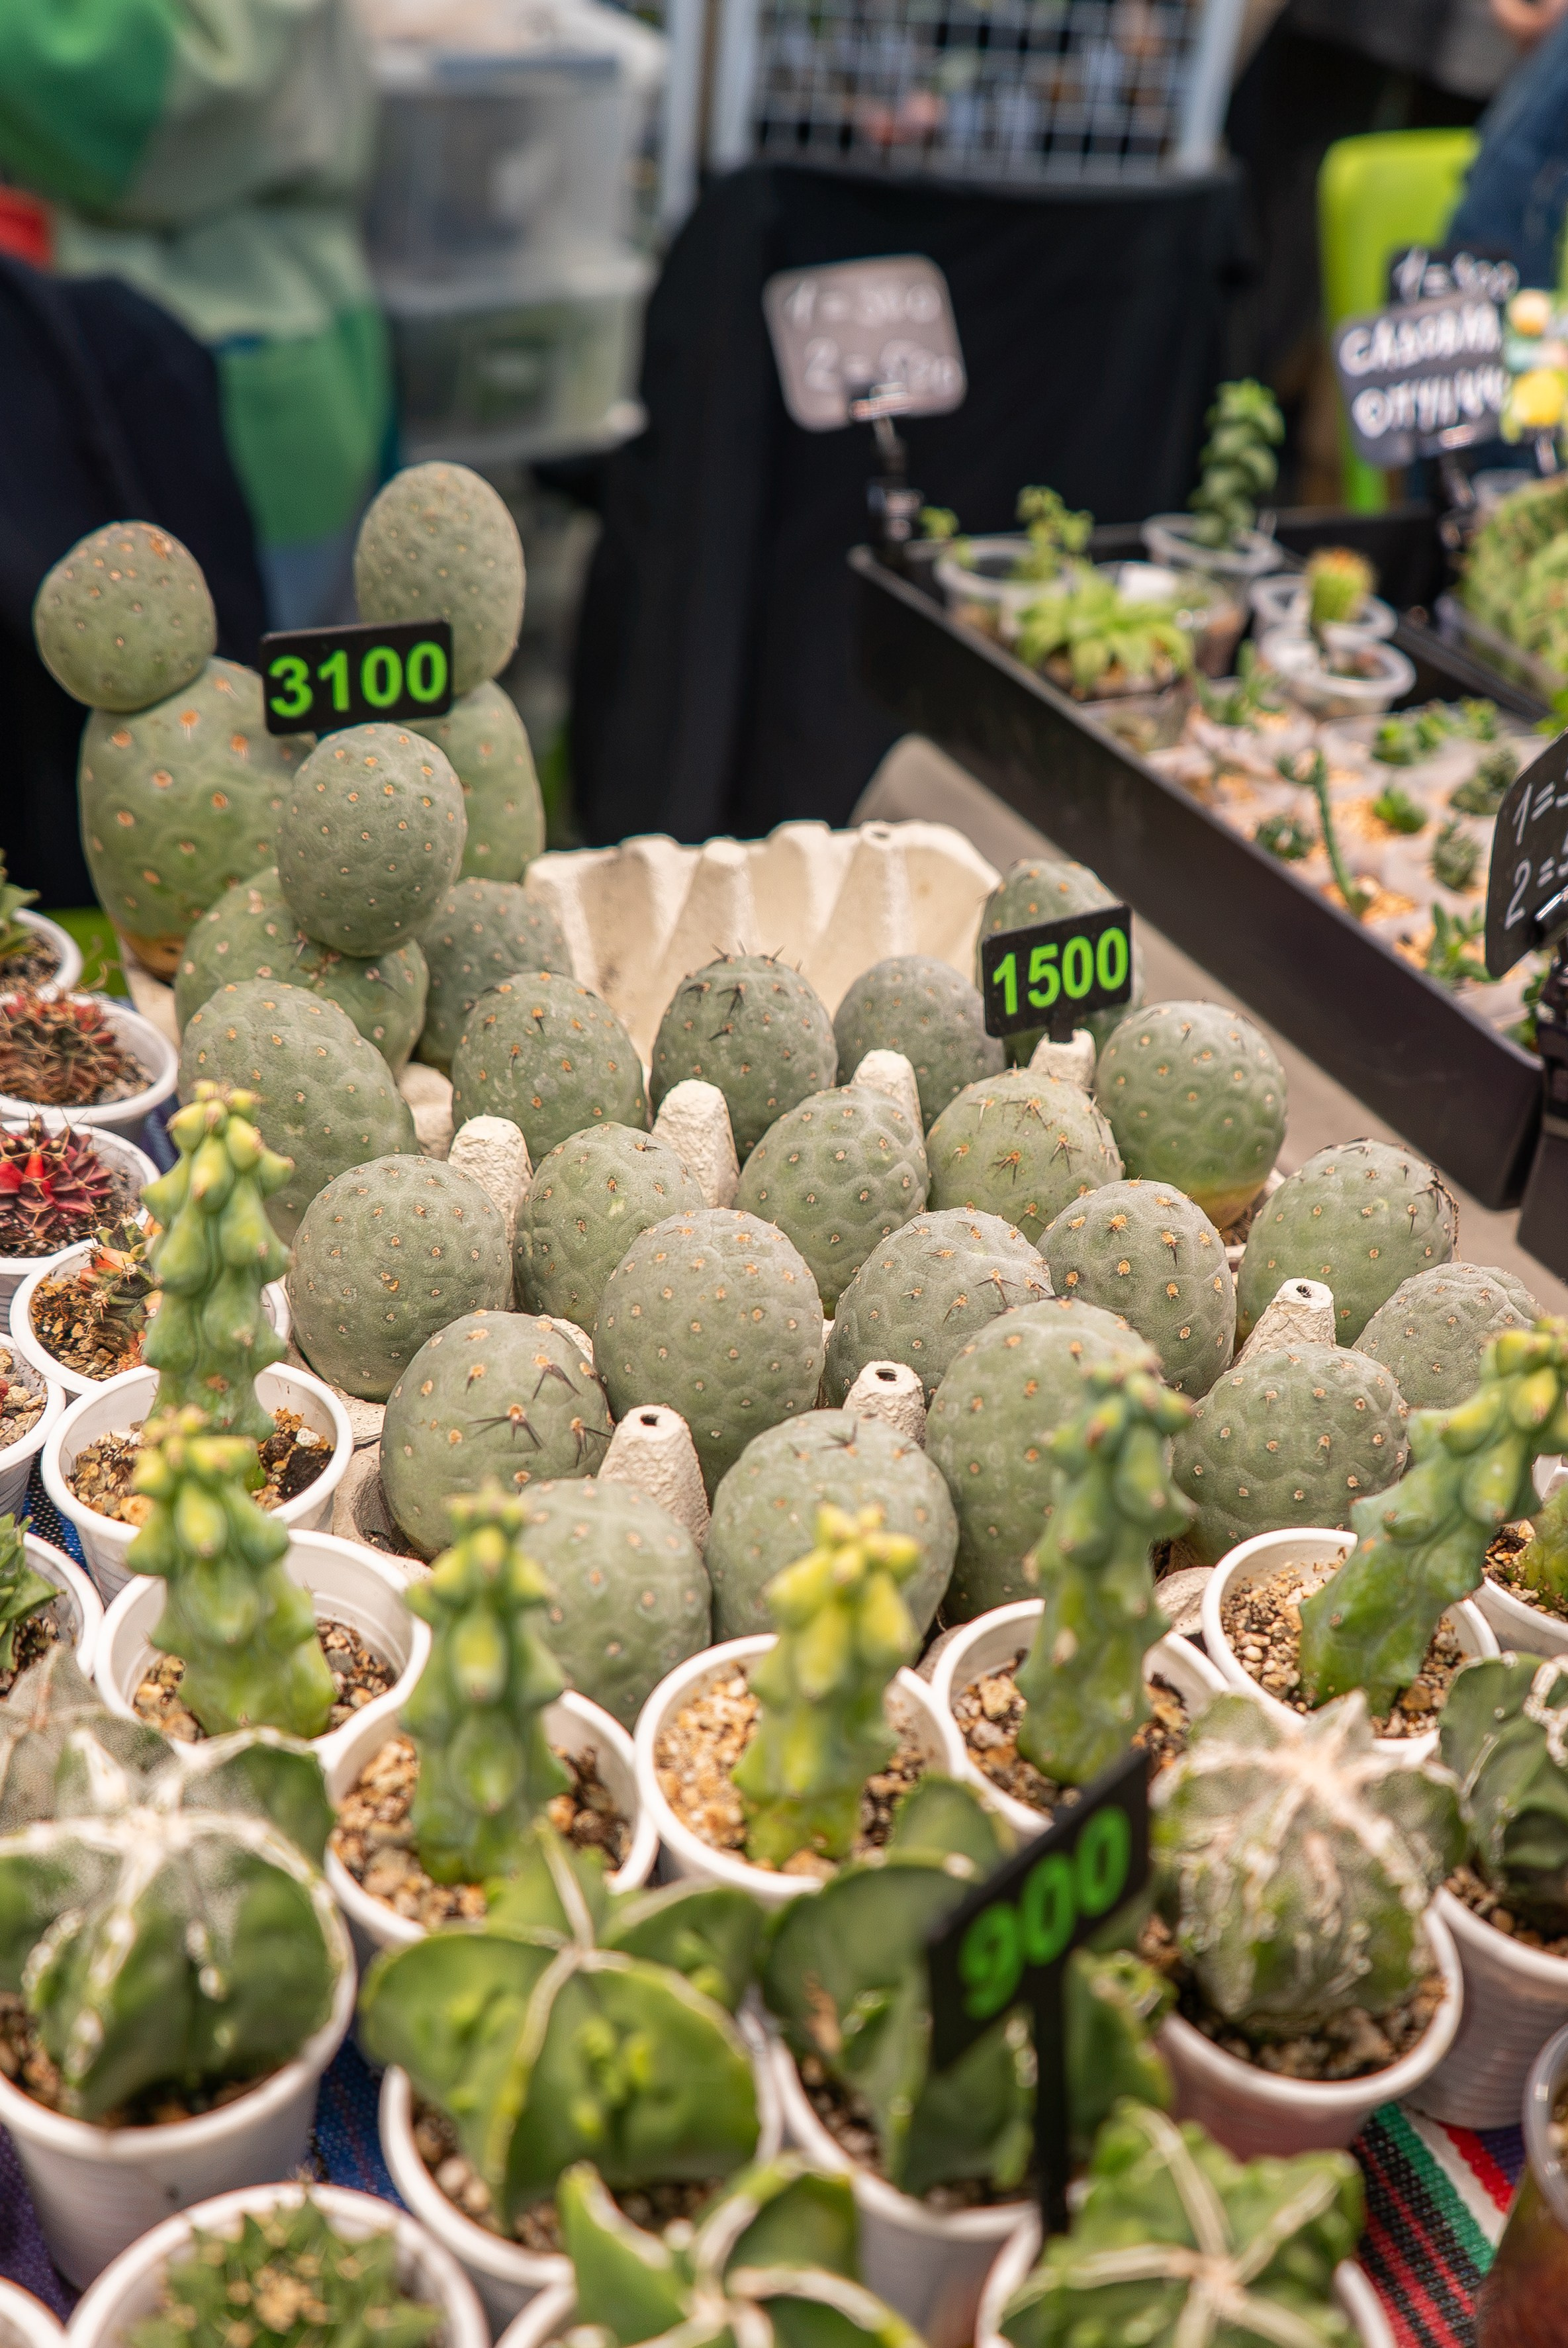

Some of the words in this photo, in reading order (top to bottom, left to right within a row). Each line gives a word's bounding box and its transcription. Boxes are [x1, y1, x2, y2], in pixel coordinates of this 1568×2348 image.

[268, 640, 447, 718] 3100
[1512, 756, 1568, 846] 1=
[1504, 829, 1568, 930] 2=
[993, 927, 1128, 1016] 1500
[957, 1805, 1131, 2022] 900
